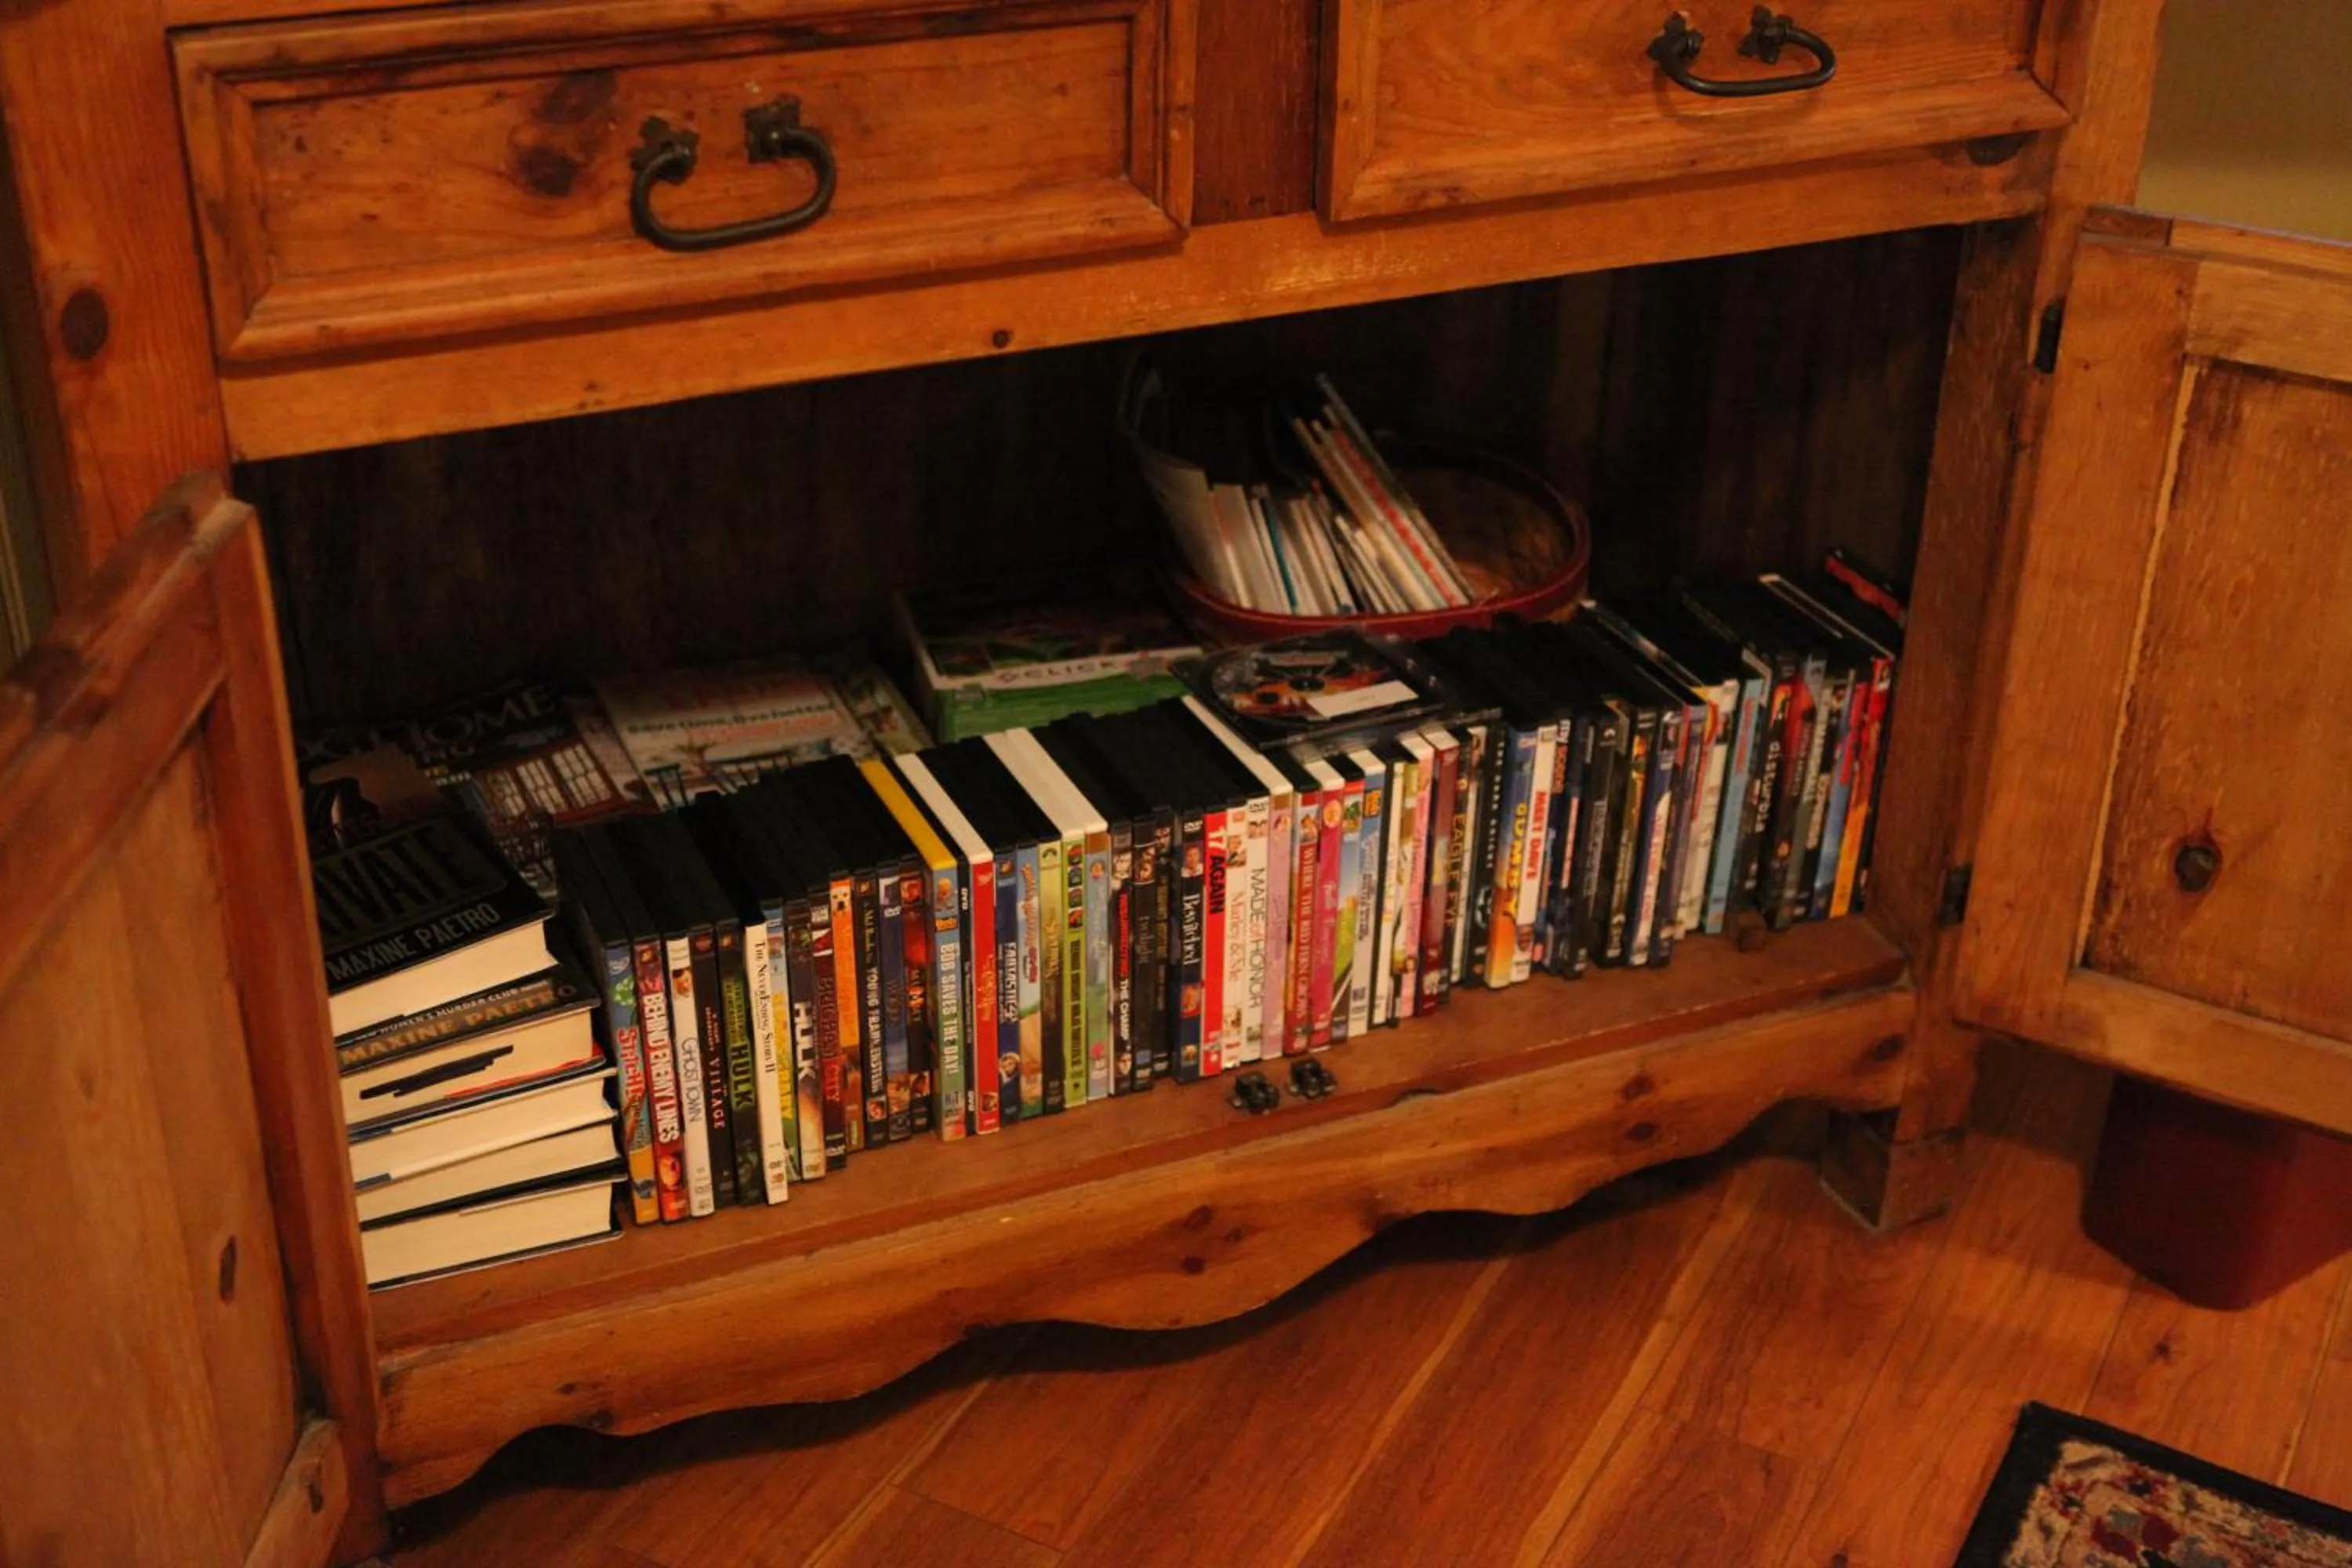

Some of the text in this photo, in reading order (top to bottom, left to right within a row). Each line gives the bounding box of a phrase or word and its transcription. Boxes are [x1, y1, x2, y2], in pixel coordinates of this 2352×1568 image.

[1495, 741, 1506, 767] THE
[1755, 740, 1780, 833] disturbia
[1491, 774, 1502, 811] DARK
[1301, 847, 1317, 889] WHERE
[1527, 790, 1548, 880] MEET DAVE
[1208, 826, 1226, 915] 17 AGAIN
[1250, 867, 1266, 922] MADE
[1299, 891, 1314, 915] THE
[1444, 813, 1468, 927] EAGLE EYE
[327, 902, 501, 981] MAXINE PAETRO
[1182, 894, 1201, 966] Bewitched
[1227, 891, 1245, 941] Marley
[1298, 920, 1312, 943] RED
[866, 967, 880, 1007] YOUNG
[1004, 942, 1018, 1005] FANTASTIC
[1120, 978, 1131, 1000] THE
[1249, 940, 1265, 1009] HONOR
[339, 984, 579, 1065] MAXINE PAETRO
[793, 1000, 816, 1082] HULK
[940, 944, 960, 1075] BOB SAVES THE DAY!
[1120, 1003, 1131, 1040] CHAMP
[642, 993, 680, 1143] BEHIND ENEMY LINES
[681, 1037, 704, 1123] GHOST TOWN
[708, 1058, 726, 1130] VILLAGE
[730, 1044, 754, 1108] HULK
[826, 1063, 840, 1102] CITY
